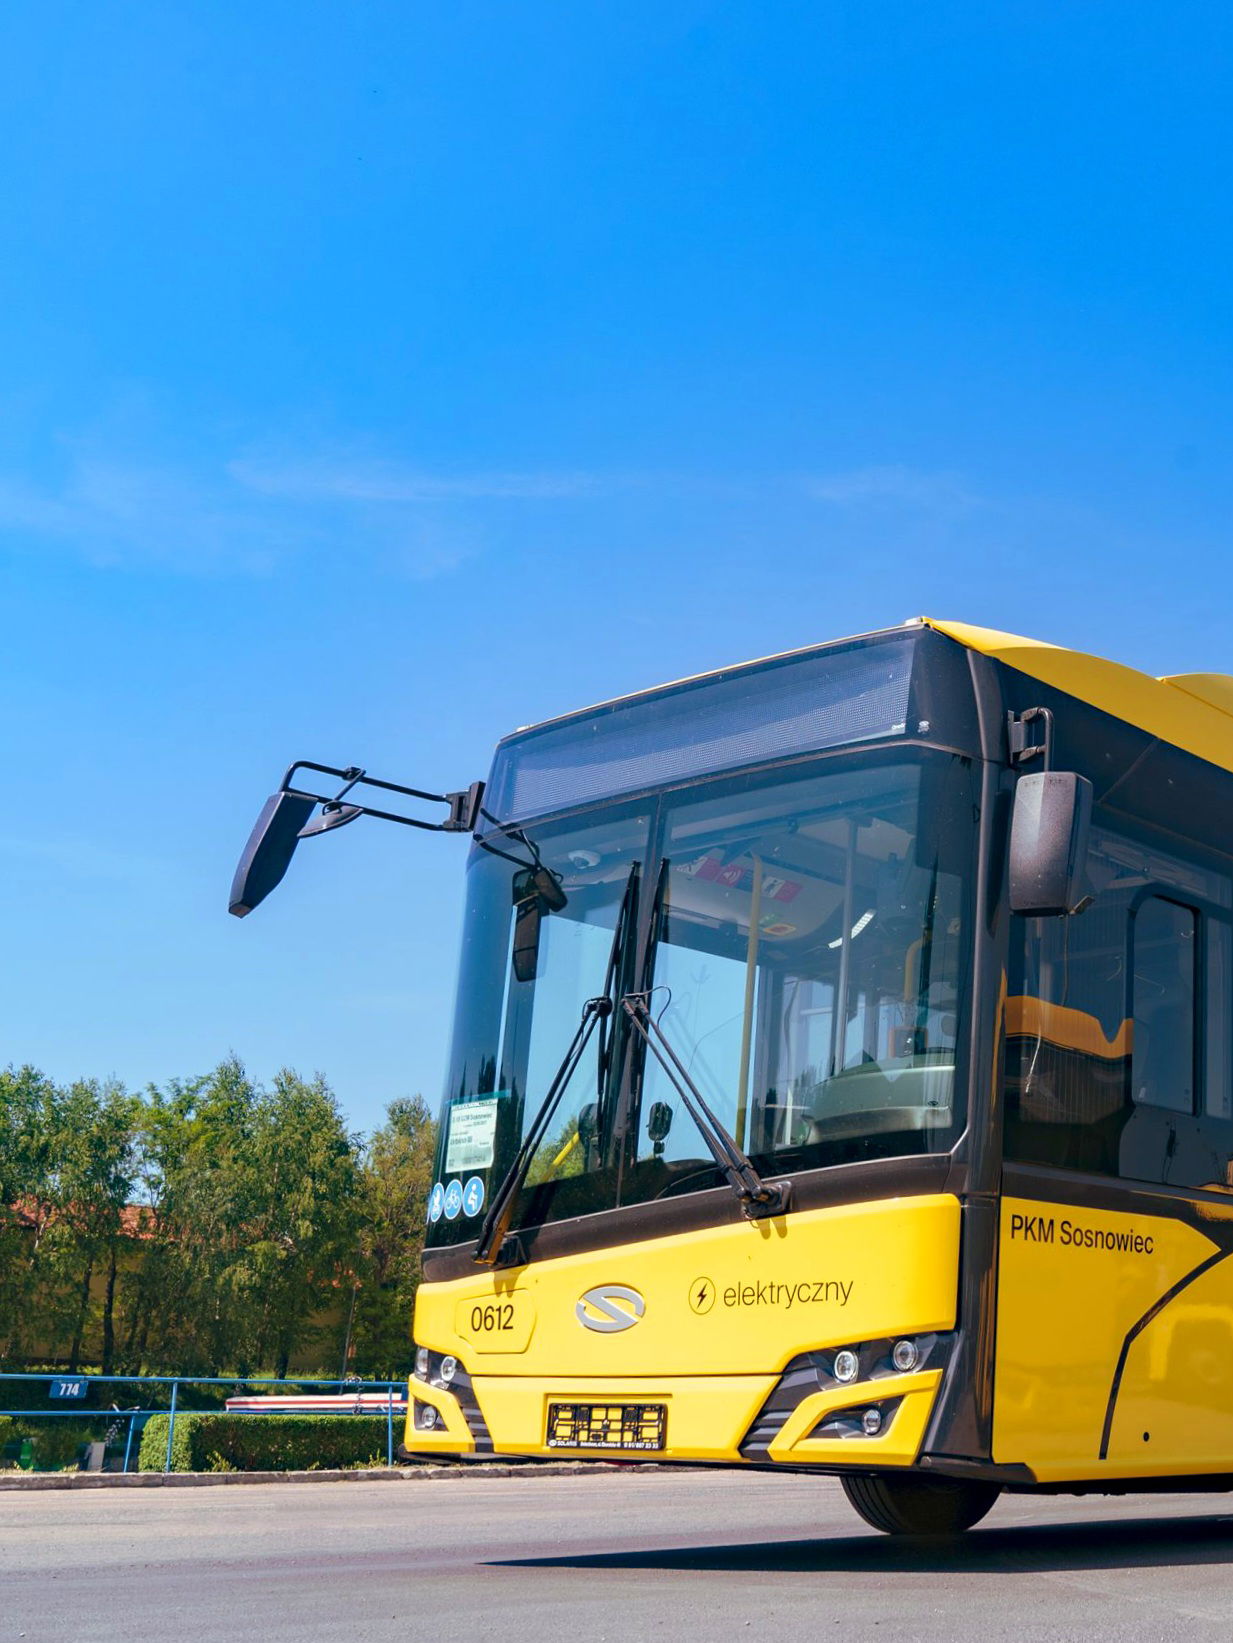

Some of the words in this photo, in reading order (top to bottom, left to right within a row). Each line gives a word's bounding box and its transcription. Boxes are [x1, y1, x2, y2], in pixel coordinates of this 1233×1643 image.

[1011, 1213, 1055, 1244] PKM
[1060, 1220, 1154, 1254] Sosnowiec
[724, 1280, 854, 1310] elektryczny
[471, 1304, 514, 1332] 0612
[59, 1383, 80, 1396] 774
